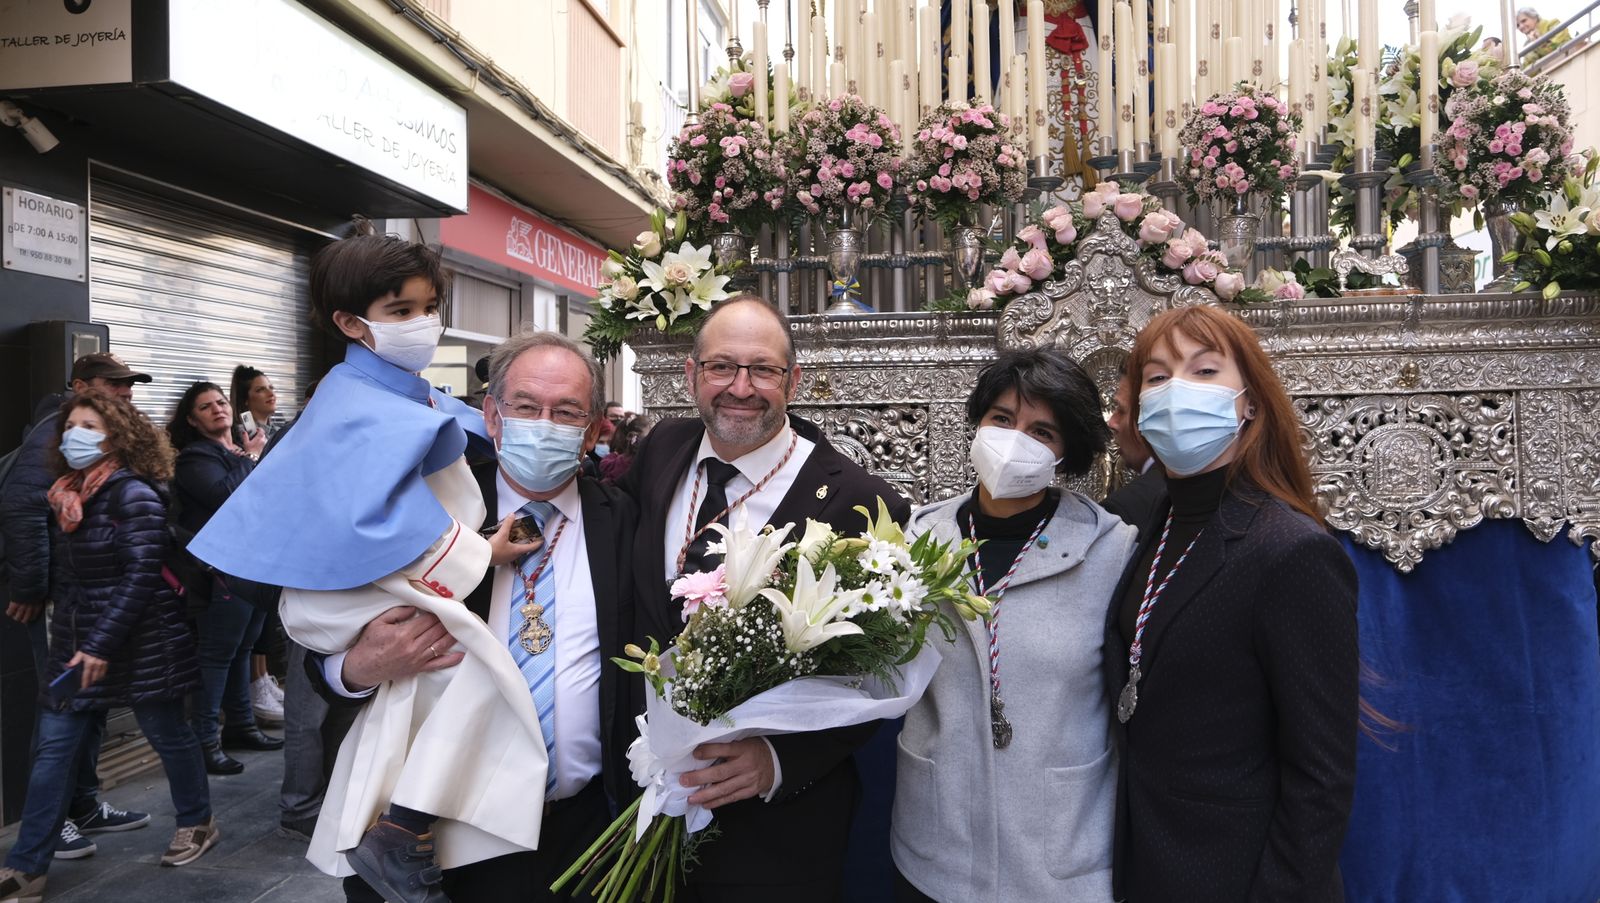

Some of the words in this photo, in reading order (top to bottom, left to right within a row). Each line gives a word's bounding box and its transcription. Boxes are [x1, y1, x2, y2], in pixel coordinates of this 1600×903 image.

[1, 36, 49, 48] TALLER
[55, 34, 71, 45] DE
[72, 28, 126, 47] JOYERÍA
[316, 111, 376, 149] ALLER
[382, 136, 401, 159] DE
[402, 149, 457, 187] JOYERÍA
[19, 195, 74, 220] HORARIO
[14, 222, 25, 233] DE
[28, 225, 46, 238] 7:00
[48, 230, 54, 240] A
[57, 232, 78, 245] 15:00
